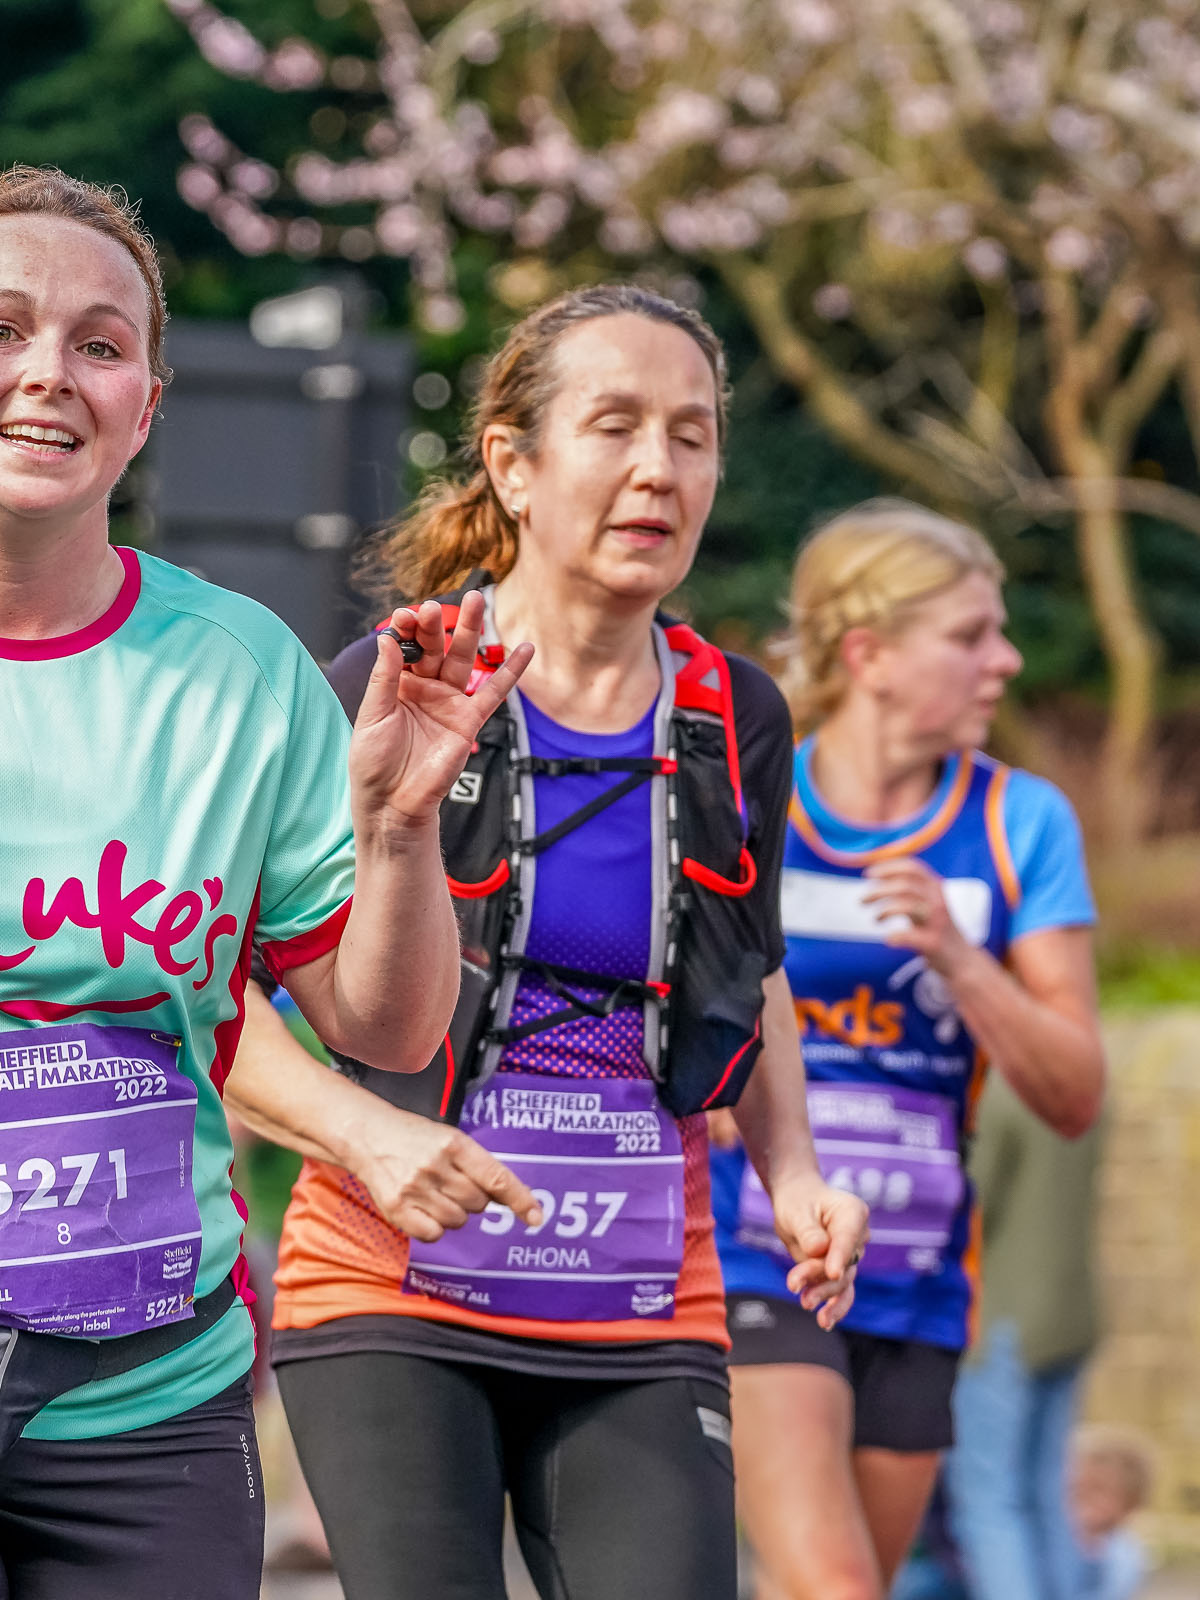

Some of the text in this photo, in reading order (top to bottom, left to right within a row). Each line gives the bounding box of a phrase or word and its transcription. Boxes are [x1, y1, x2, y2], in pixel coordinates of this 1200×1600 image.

[40, 1059, 163, 1087] MARATHON
[114, 1075, 168, 1102] 2022
[505, 1091, 597, 1111] SHEFFIELD
[502, 1109, 657, 1130] HALF MARATHON
[615, 1132, 661, 1154] 2022
[57, 1222, 72, 1245] 8
[506, 1245, 592, 1269] RHONA
[89, 1307, 117, 1319] perforated
[145, 1293, 185, 1322] 5271
[83, 1316, 111, 1332] label
[240, 1433, 255, 1499] DOMYOS
